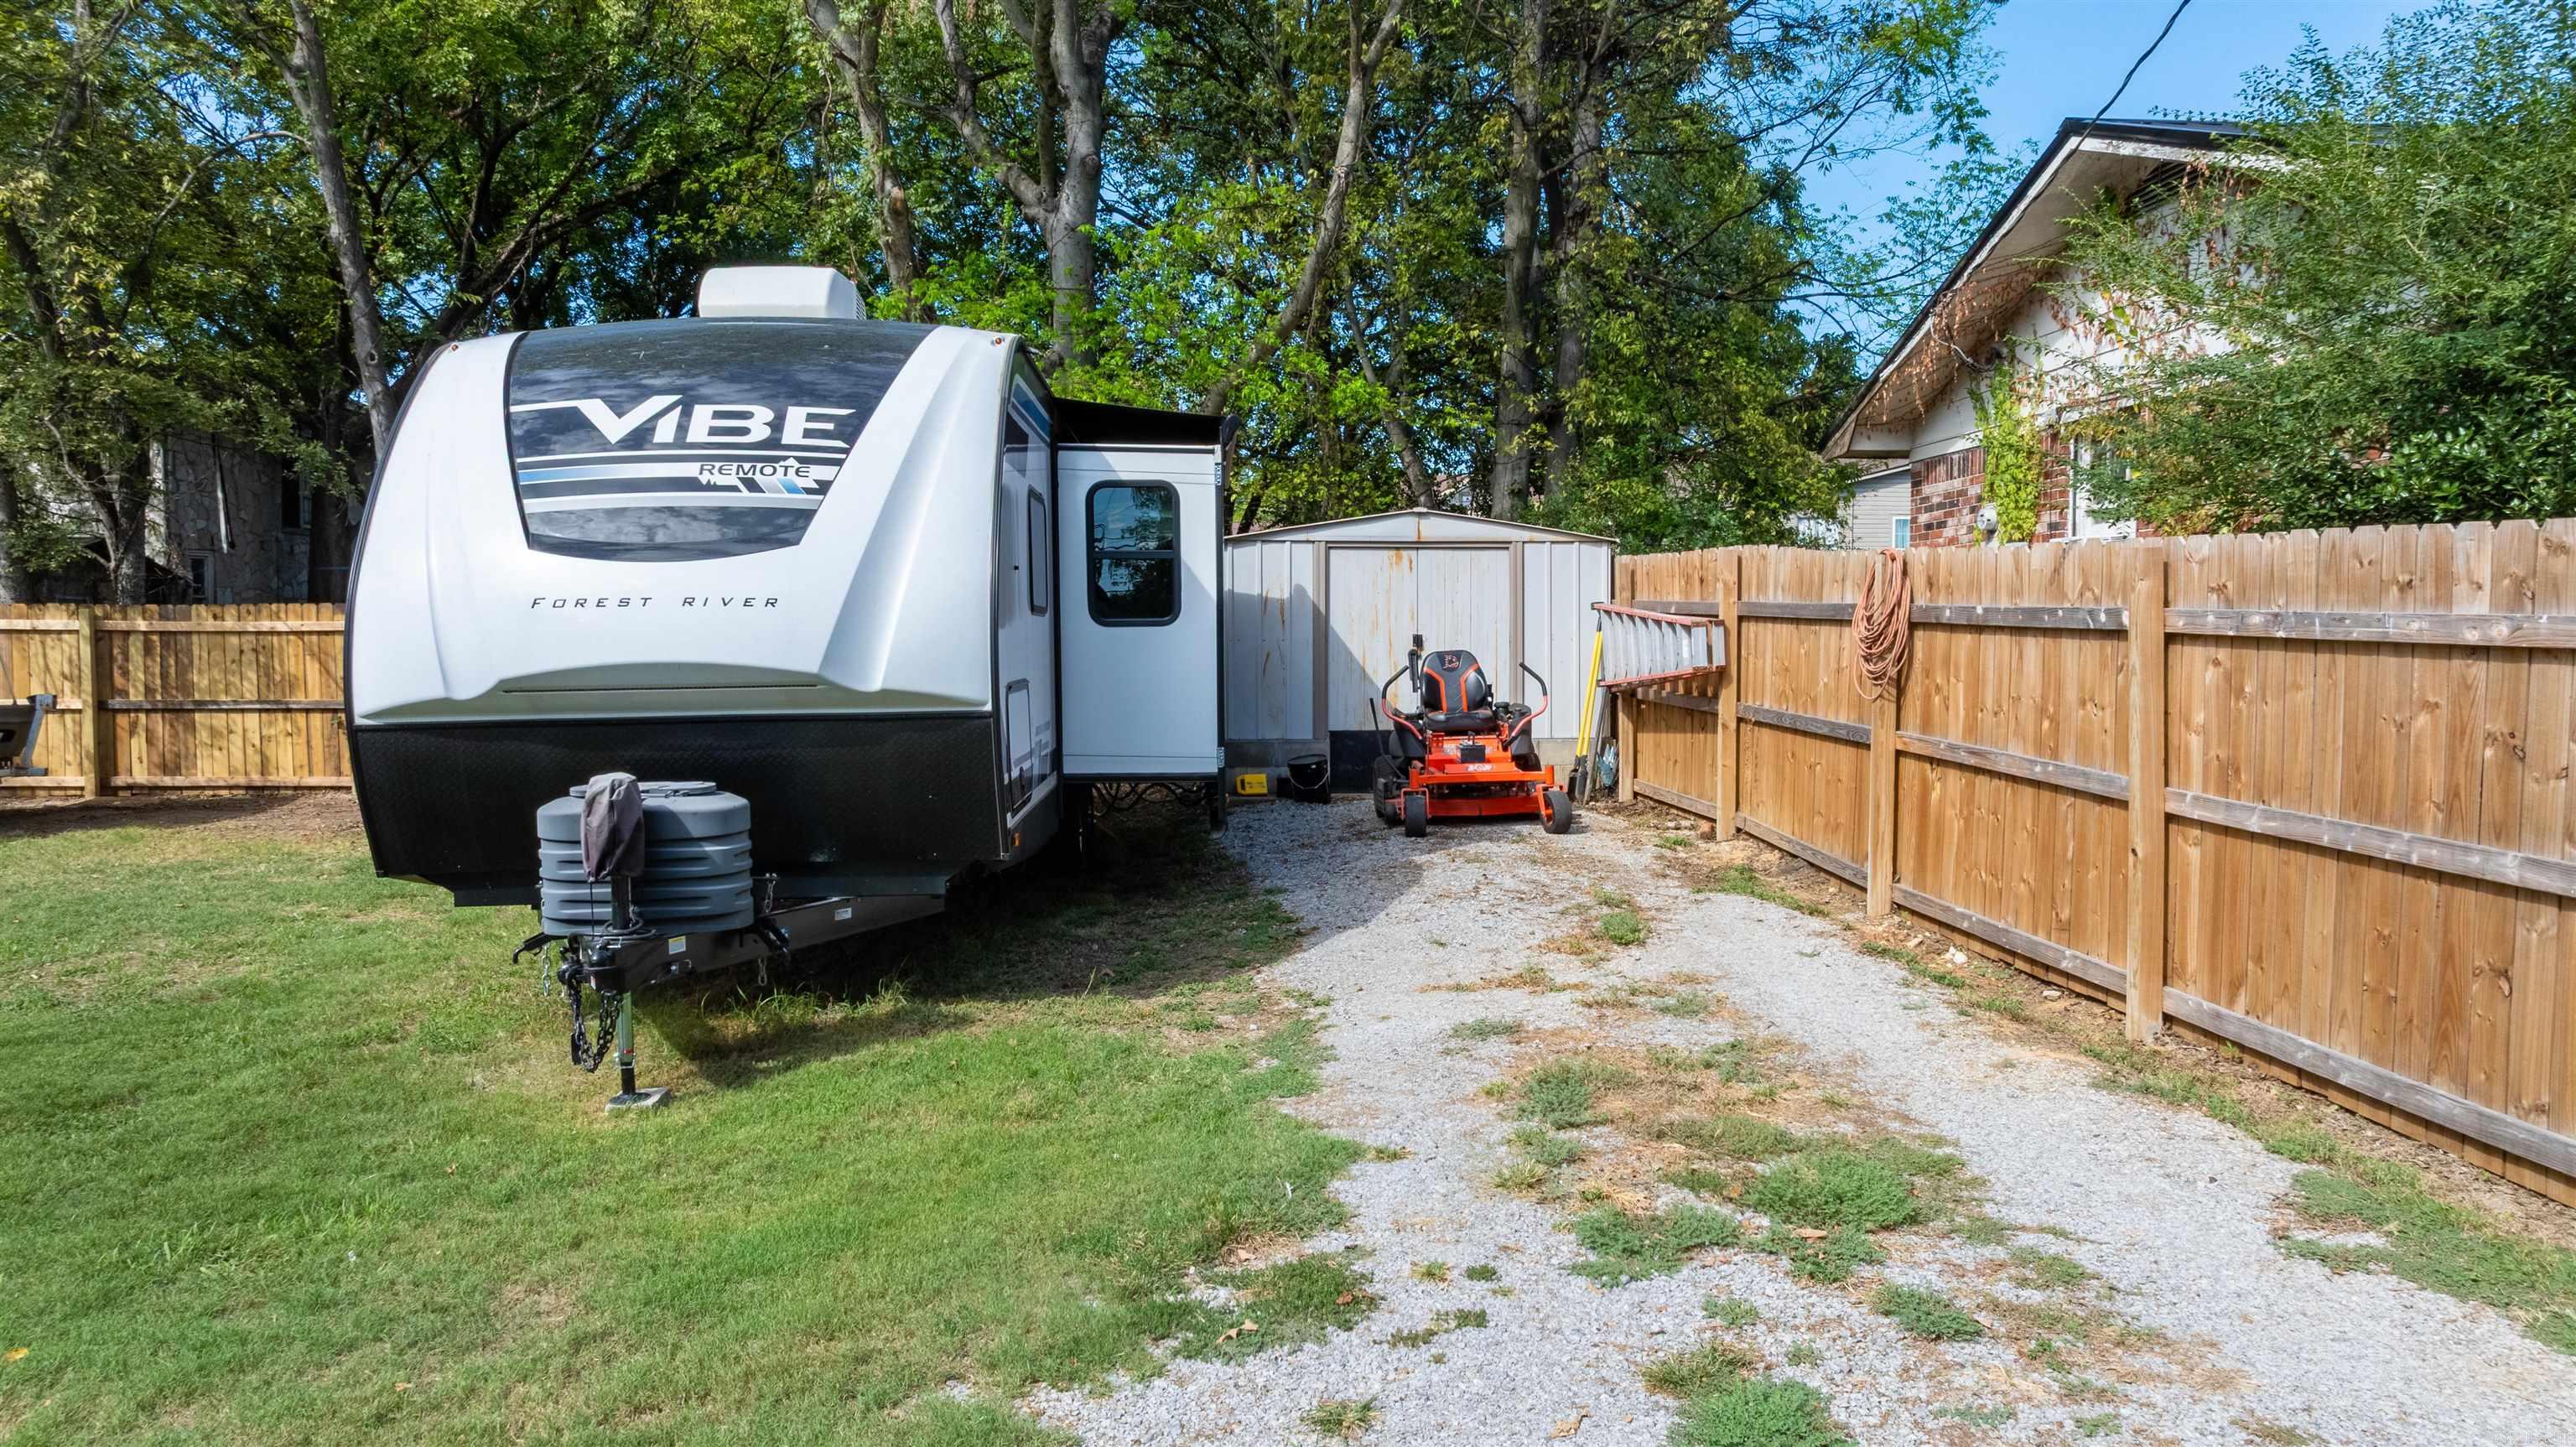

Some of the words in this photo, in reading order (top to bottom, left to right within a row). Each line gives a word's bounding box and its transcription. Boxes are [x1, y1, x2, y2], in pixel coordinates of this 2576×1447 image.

[510, 395, 856, 449] VIBE
[699, 463, 811, 479] REMOTE
[530, 596, 654, 609] FOREST
[681, 596, 779, 609] RIVER
